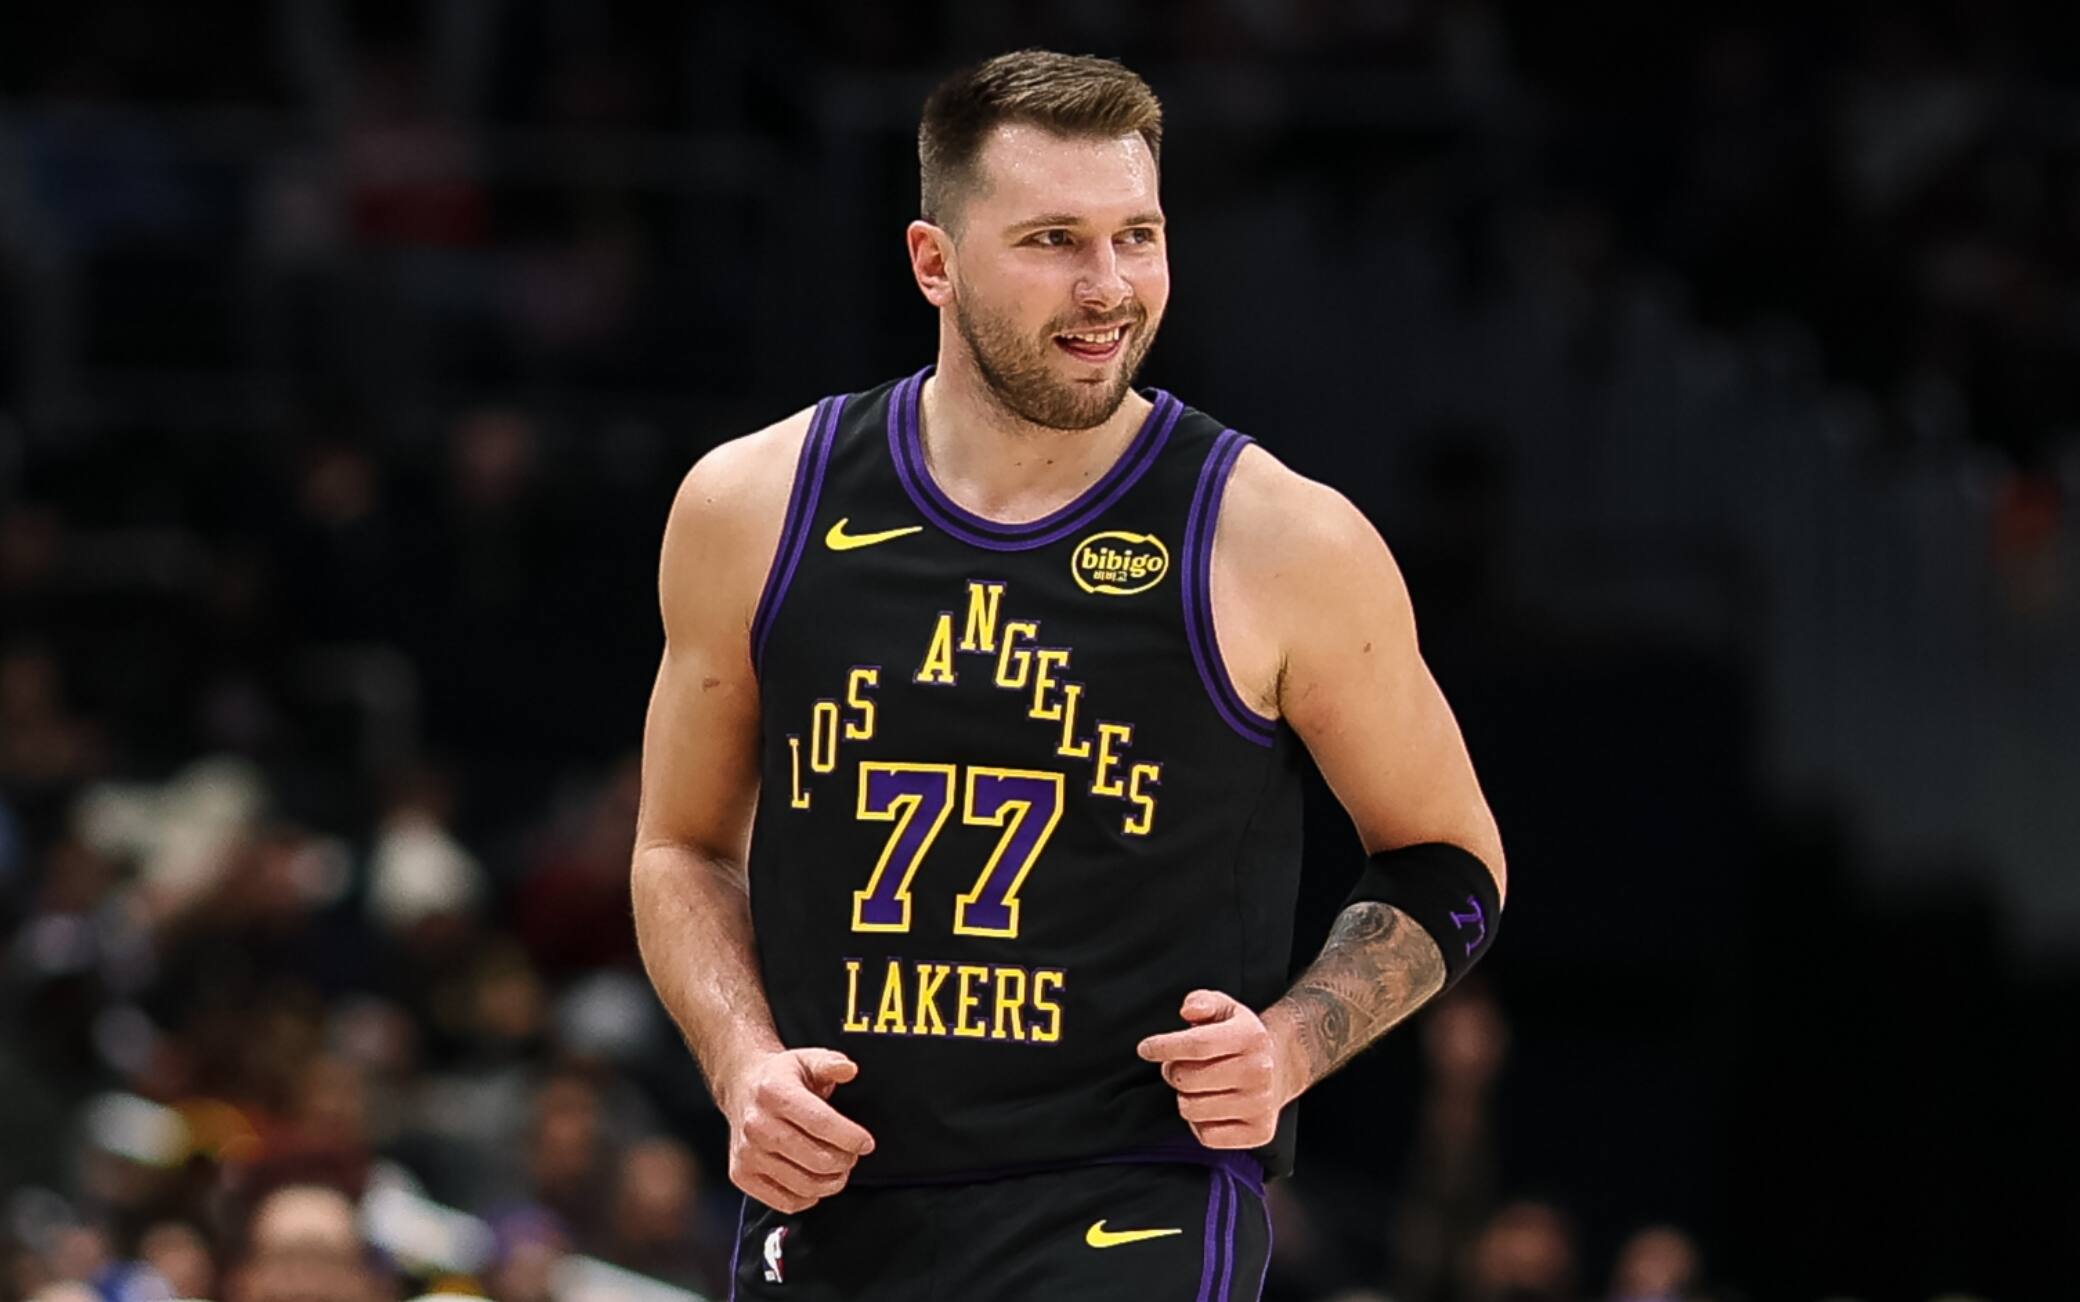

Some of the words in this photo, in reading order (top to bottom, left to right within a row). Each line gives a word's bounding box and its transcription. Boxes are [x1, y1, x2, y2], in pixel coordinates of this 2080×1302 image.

[1082, 547, 1163, 578] bibigo
[787, 665, 881, 810] LOS
[912, 579, 1162, 836] ANGELES
[852, 761, 1064, 938] 77
[841, 957, 1067, 1044] LAKERS
